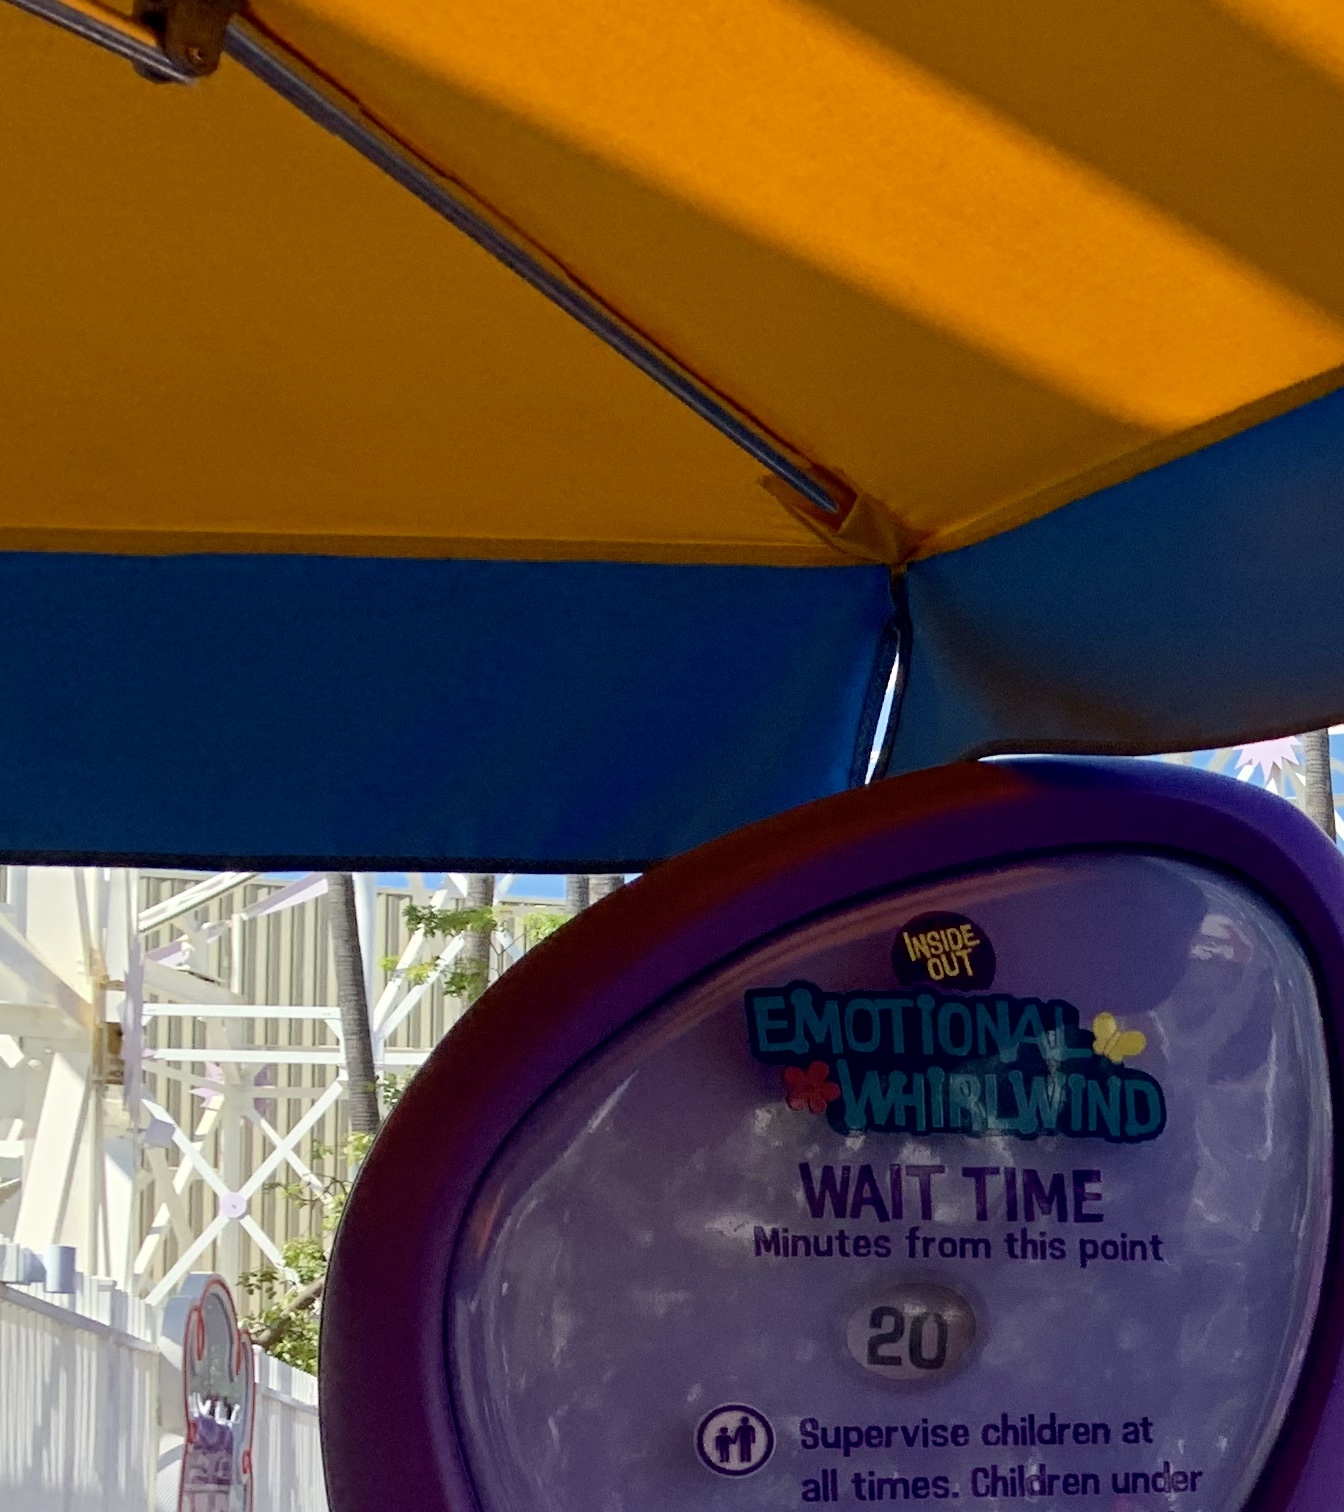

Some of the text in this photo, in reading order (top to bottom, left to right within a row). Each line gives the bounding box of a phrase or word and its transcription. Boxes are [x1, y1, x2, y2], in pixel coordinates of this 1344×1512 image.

[902, 924, 980, 961] INSIDE
[927, 948, 973, 981] OUT
[753, 988, 1095, 1058] EMOTIONAL
[838, 1060, 1164, 1137] WHIRLWIND
[800, 1161, 1103, 1224] WAIT TIME
[754, 1228, 1163, 1267] Minutes from this point
[866, 1305, 948, 1370] 20
[800, 1412, 1154, 1457] Supervise children at
[801, 1461, 1203, 1502] all times. Children under
